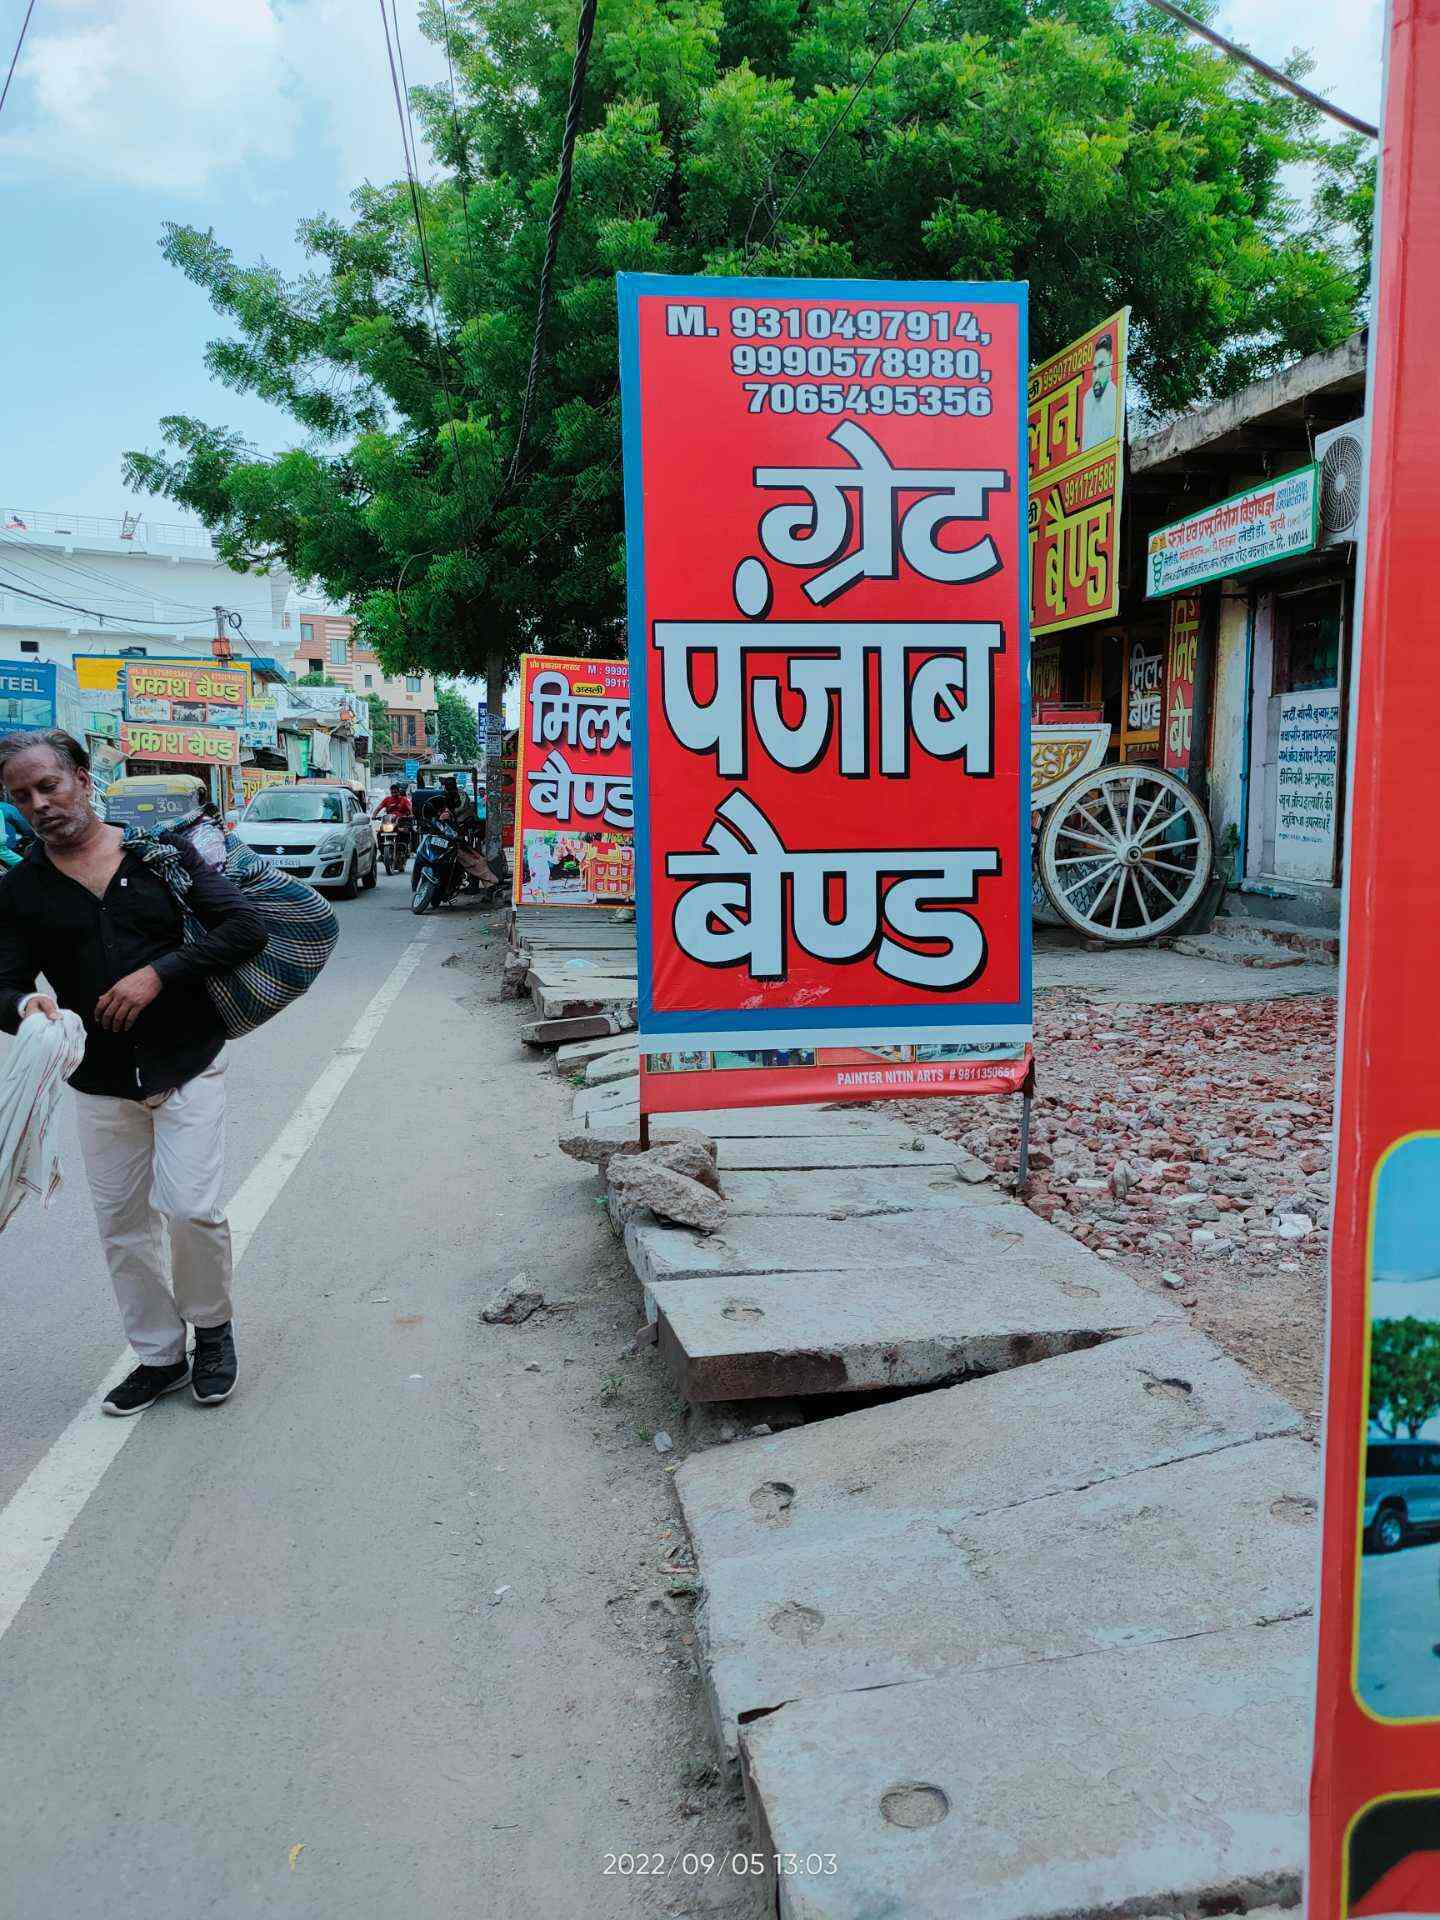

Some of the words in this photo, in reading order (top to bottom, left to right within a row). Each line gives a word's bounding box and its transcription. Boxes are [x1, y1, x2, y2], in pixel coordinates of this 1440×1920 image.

[666, 304, 719, 337] M.
[730, 306, 992, 346] 9310497914,
[731, 345, 991, 382] 9990578980,
[743, 382, 992, 417] 7065495356
[752, 418, 1011, 607] ग्रेट
[0, 676, 44, 692] TEEL
[652, 556, 1006, 779] पंजाब
[664, 787, 1003, 992] बैण्ड
[836, 1071, 883, 1087] PAINTER
[885, 1070, 914, 1085] NITIN
[916, 1069, 944, 1083] ARTS
